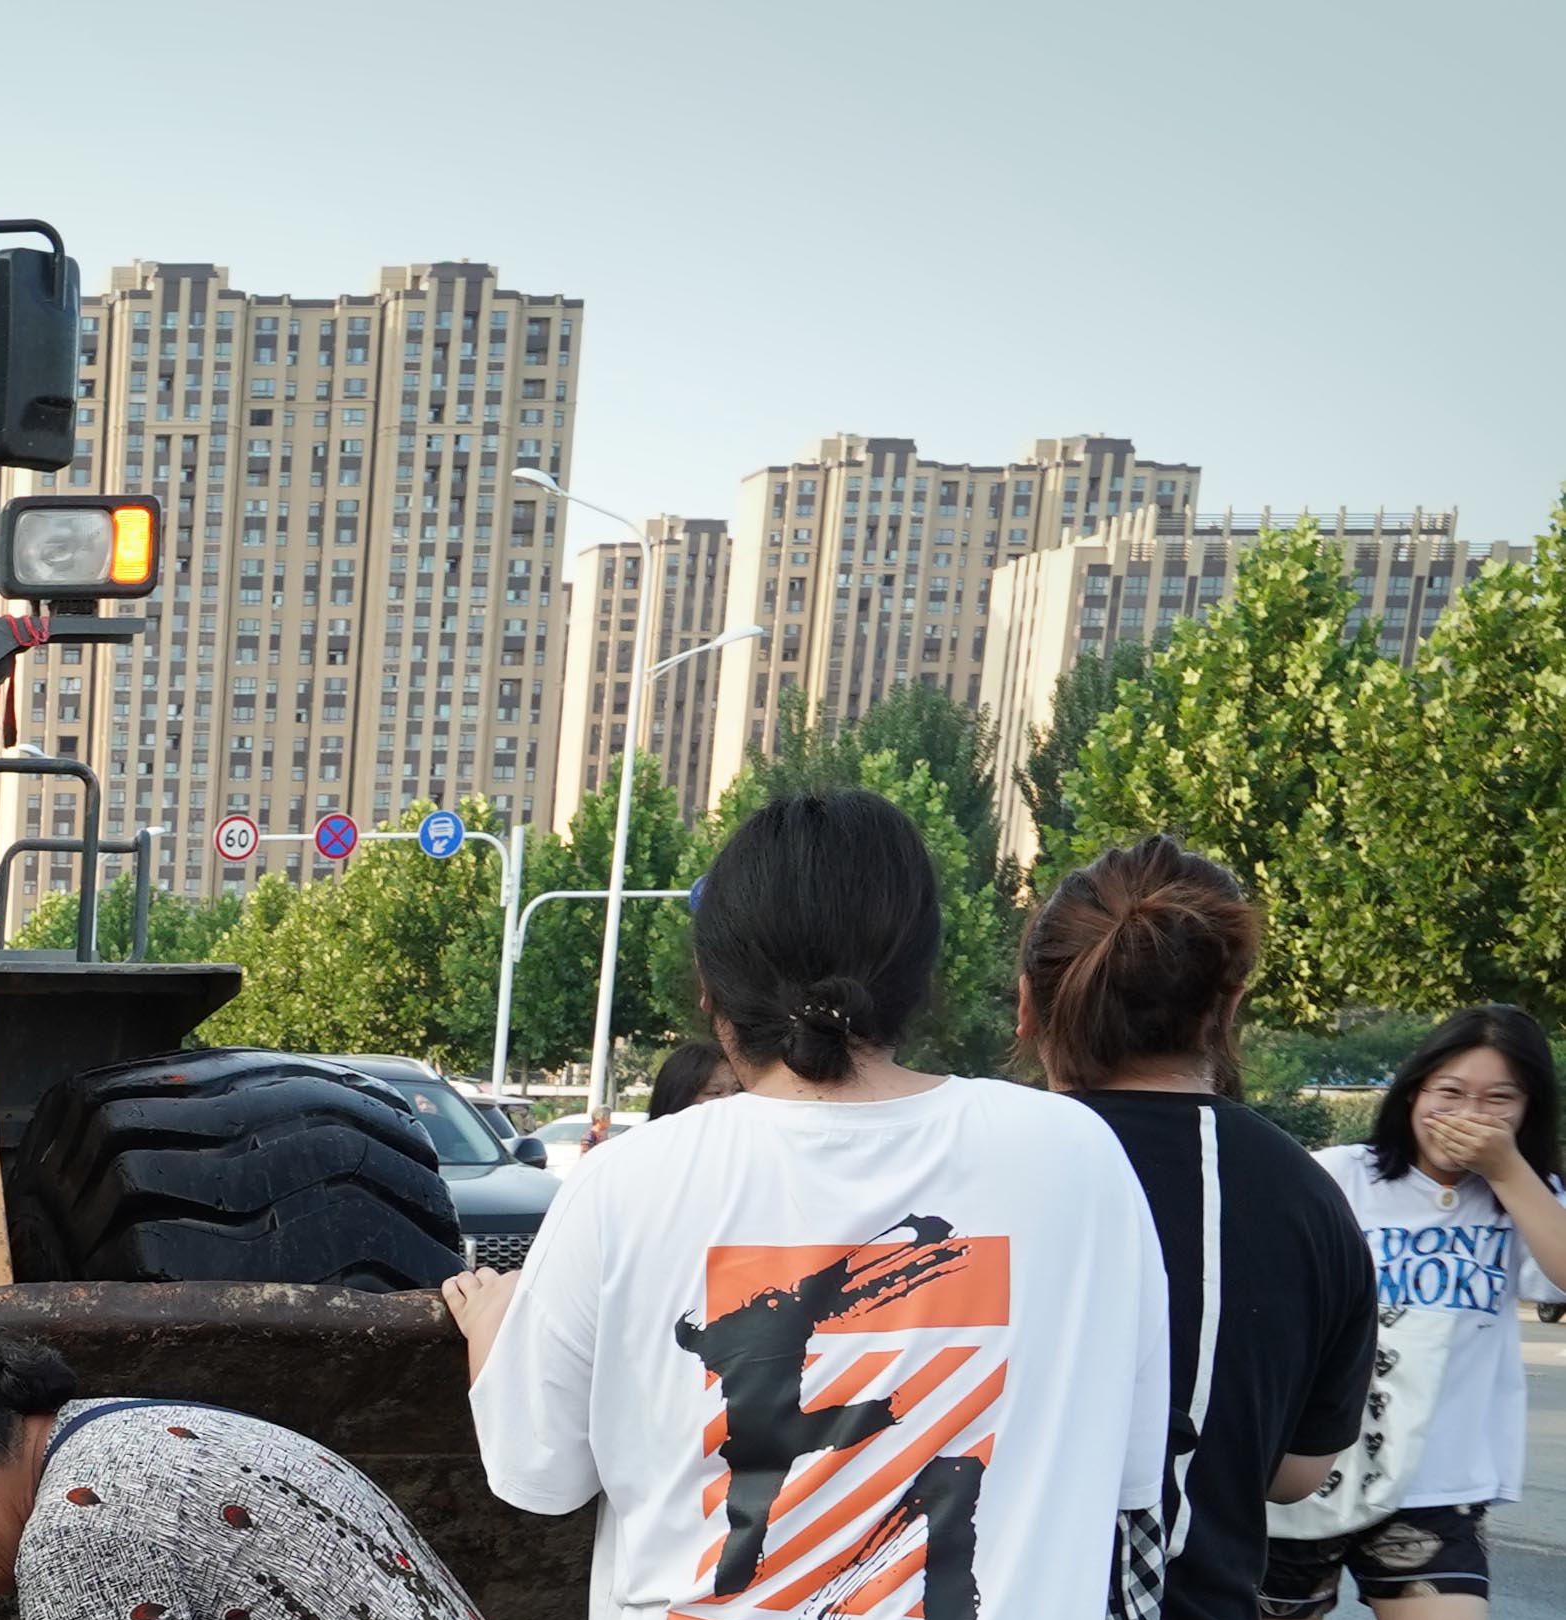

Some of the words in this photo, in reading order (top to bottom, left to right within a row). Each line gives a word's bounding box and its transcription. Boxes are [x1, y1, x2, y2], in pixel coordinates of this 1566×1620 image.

[225, 829, 249, 848] 60
[1379, 1225, 1514, 1272] DON'T
[1378, 1257, 1505, 1315] MOKE
